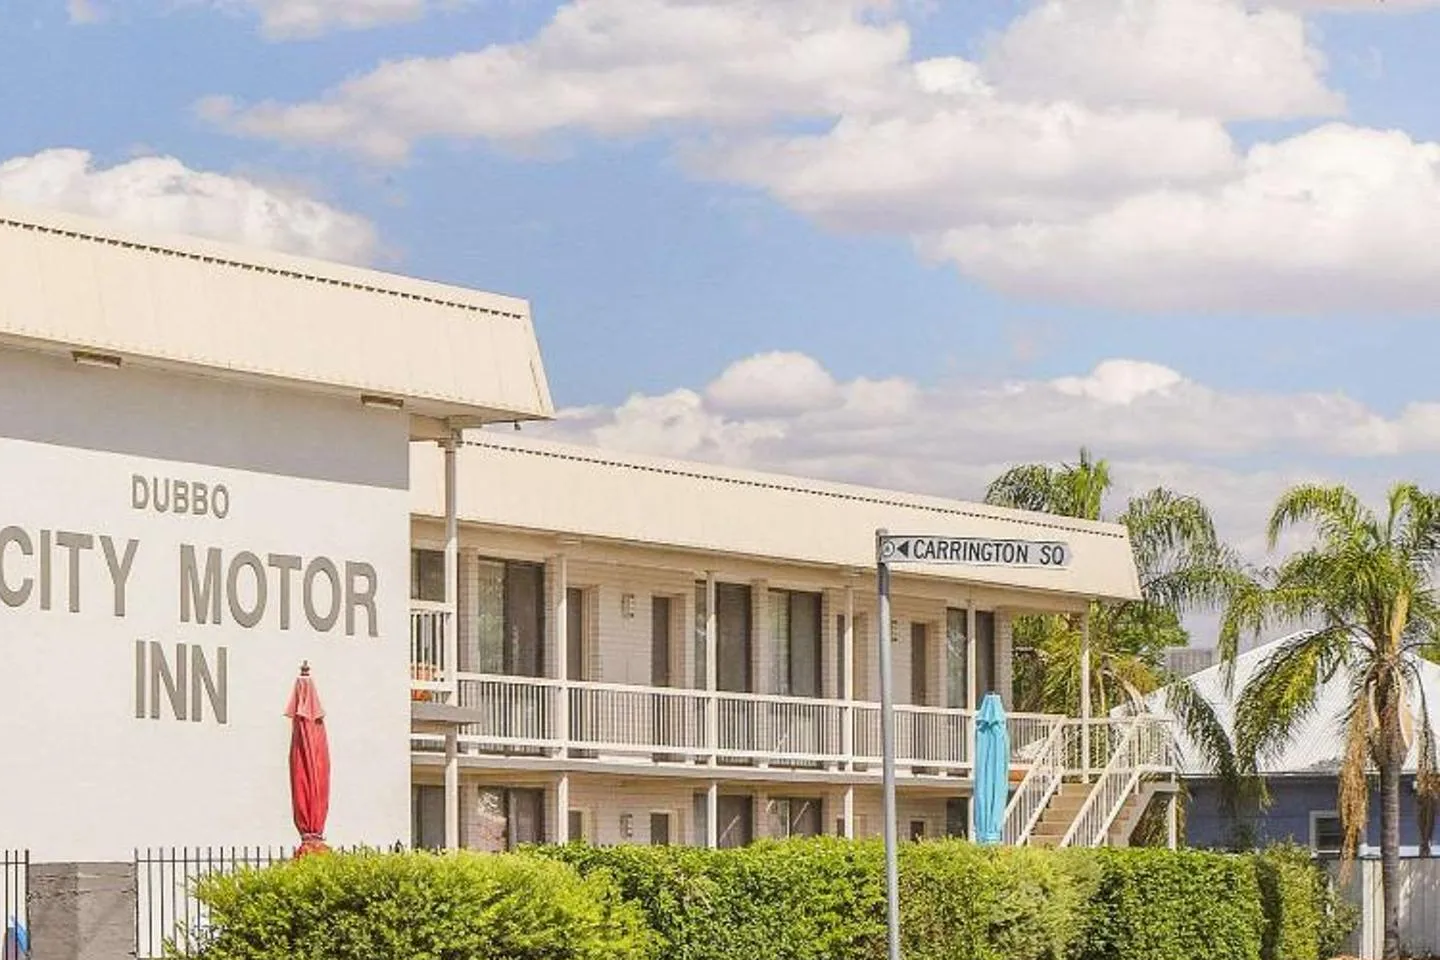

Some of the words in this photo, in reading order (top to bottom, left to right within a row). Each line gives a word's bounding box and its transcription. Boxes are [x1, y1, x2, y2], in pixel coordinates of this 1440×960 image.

[132, 475, 229, 518] DUBBO
[913, 539, 1029, 563] CARRINGTON
[179, 543, 379, 637] MOTOR
[135, 640, 228, 724] INN
